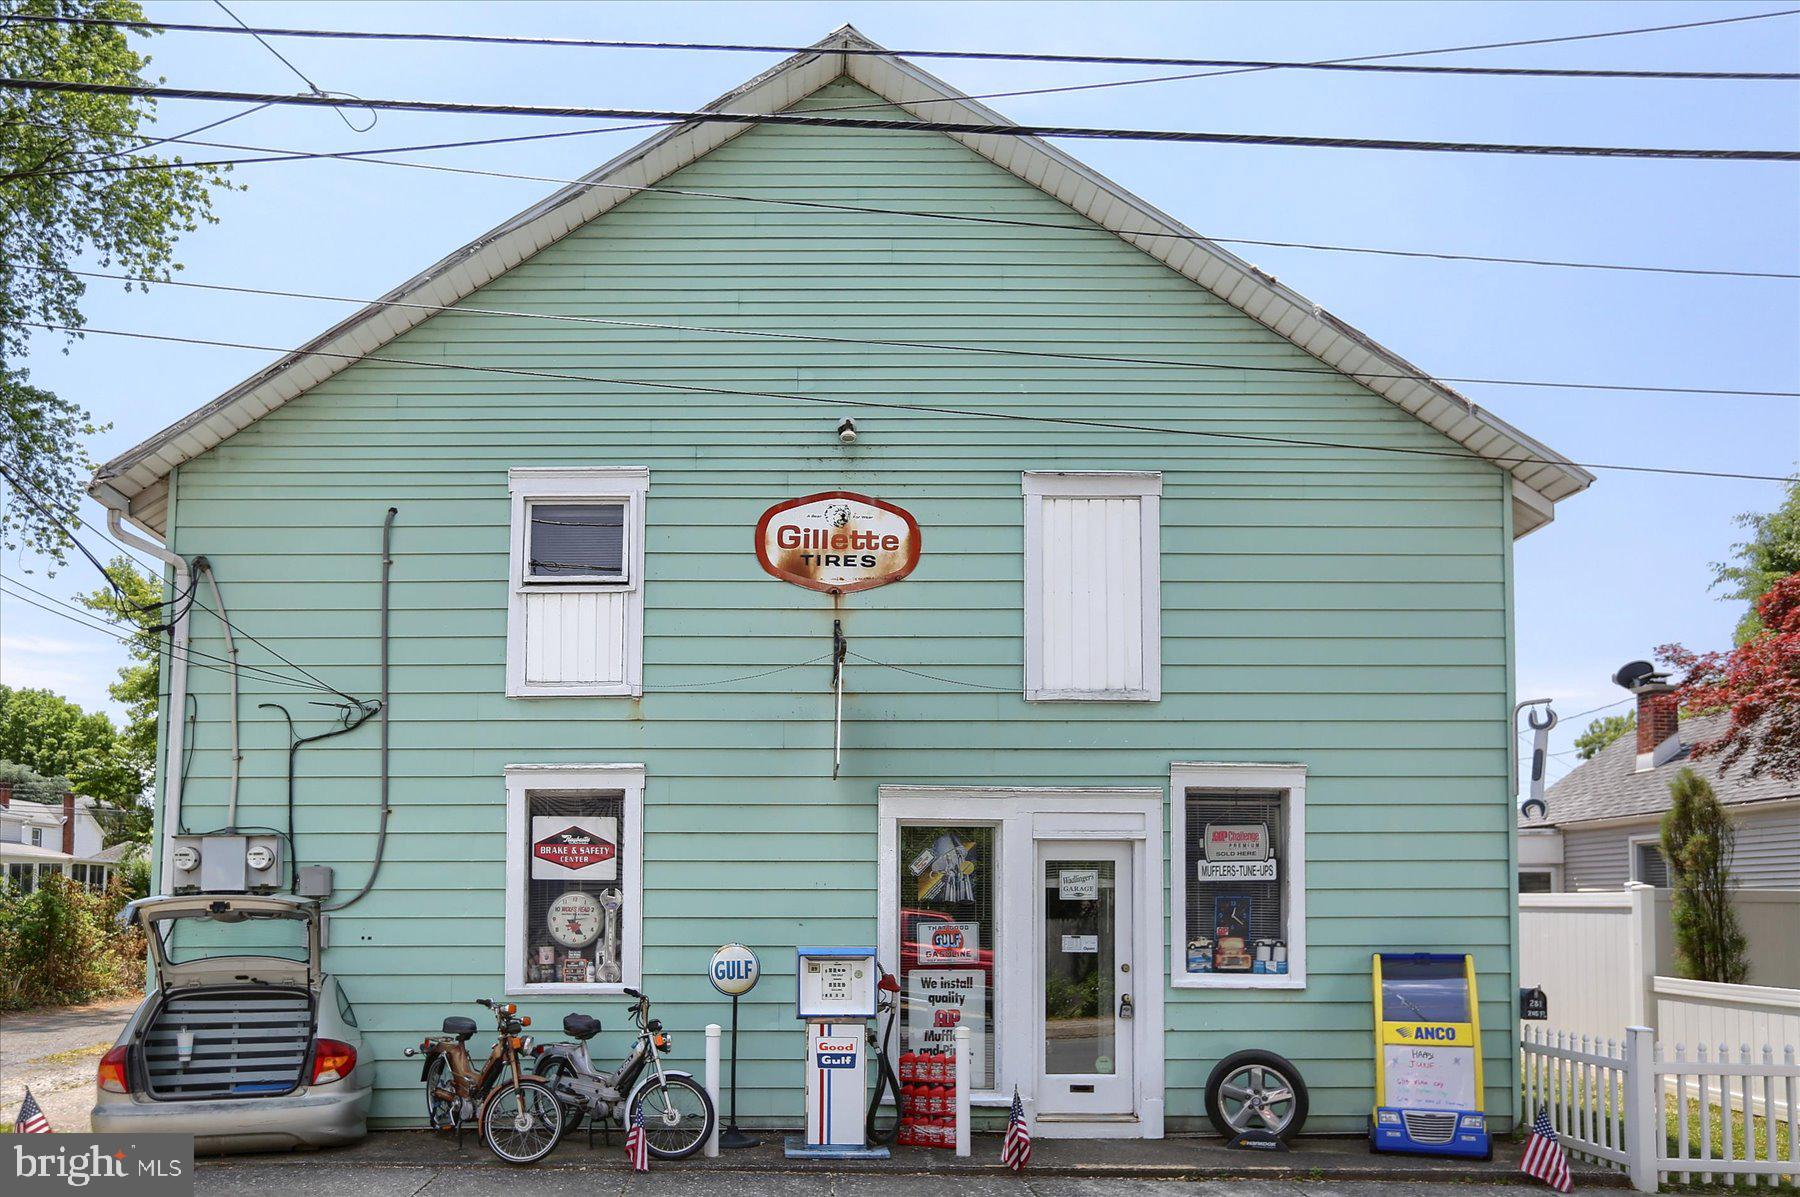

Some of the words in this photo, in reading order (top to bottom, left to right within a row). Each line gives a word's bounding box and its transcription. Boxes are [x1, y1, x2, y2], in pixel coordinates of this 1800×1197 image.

[777, 525, 900, 550] Gillette
[801, 554, 877, 567] TIRES
[1228, 831, 1260, 842] Challenge
[540, 846, 568, 854] BRAKE
[571, 846, 578, 854] &
[579, 846, 610, 855] SAFETY
[1201, 865, 1274, 877] MUFFLERS-TUNE-UPS
[935, 933, 961, 948] GULF
[925, 950, 972, 958] GASOLINE
[715, 960, 753, 980] GULF
[921, 977, 937, 989] We
[940, 977, 973, 989] install
[928, 991, 965, 1006] quality
[933, 1009, 961, 1027] AP
[1414, 1026, 1456, 1041] ANCO
[819, 1042, 853, 1051] Good
[821, 1055, 852, 1065] Gulf
